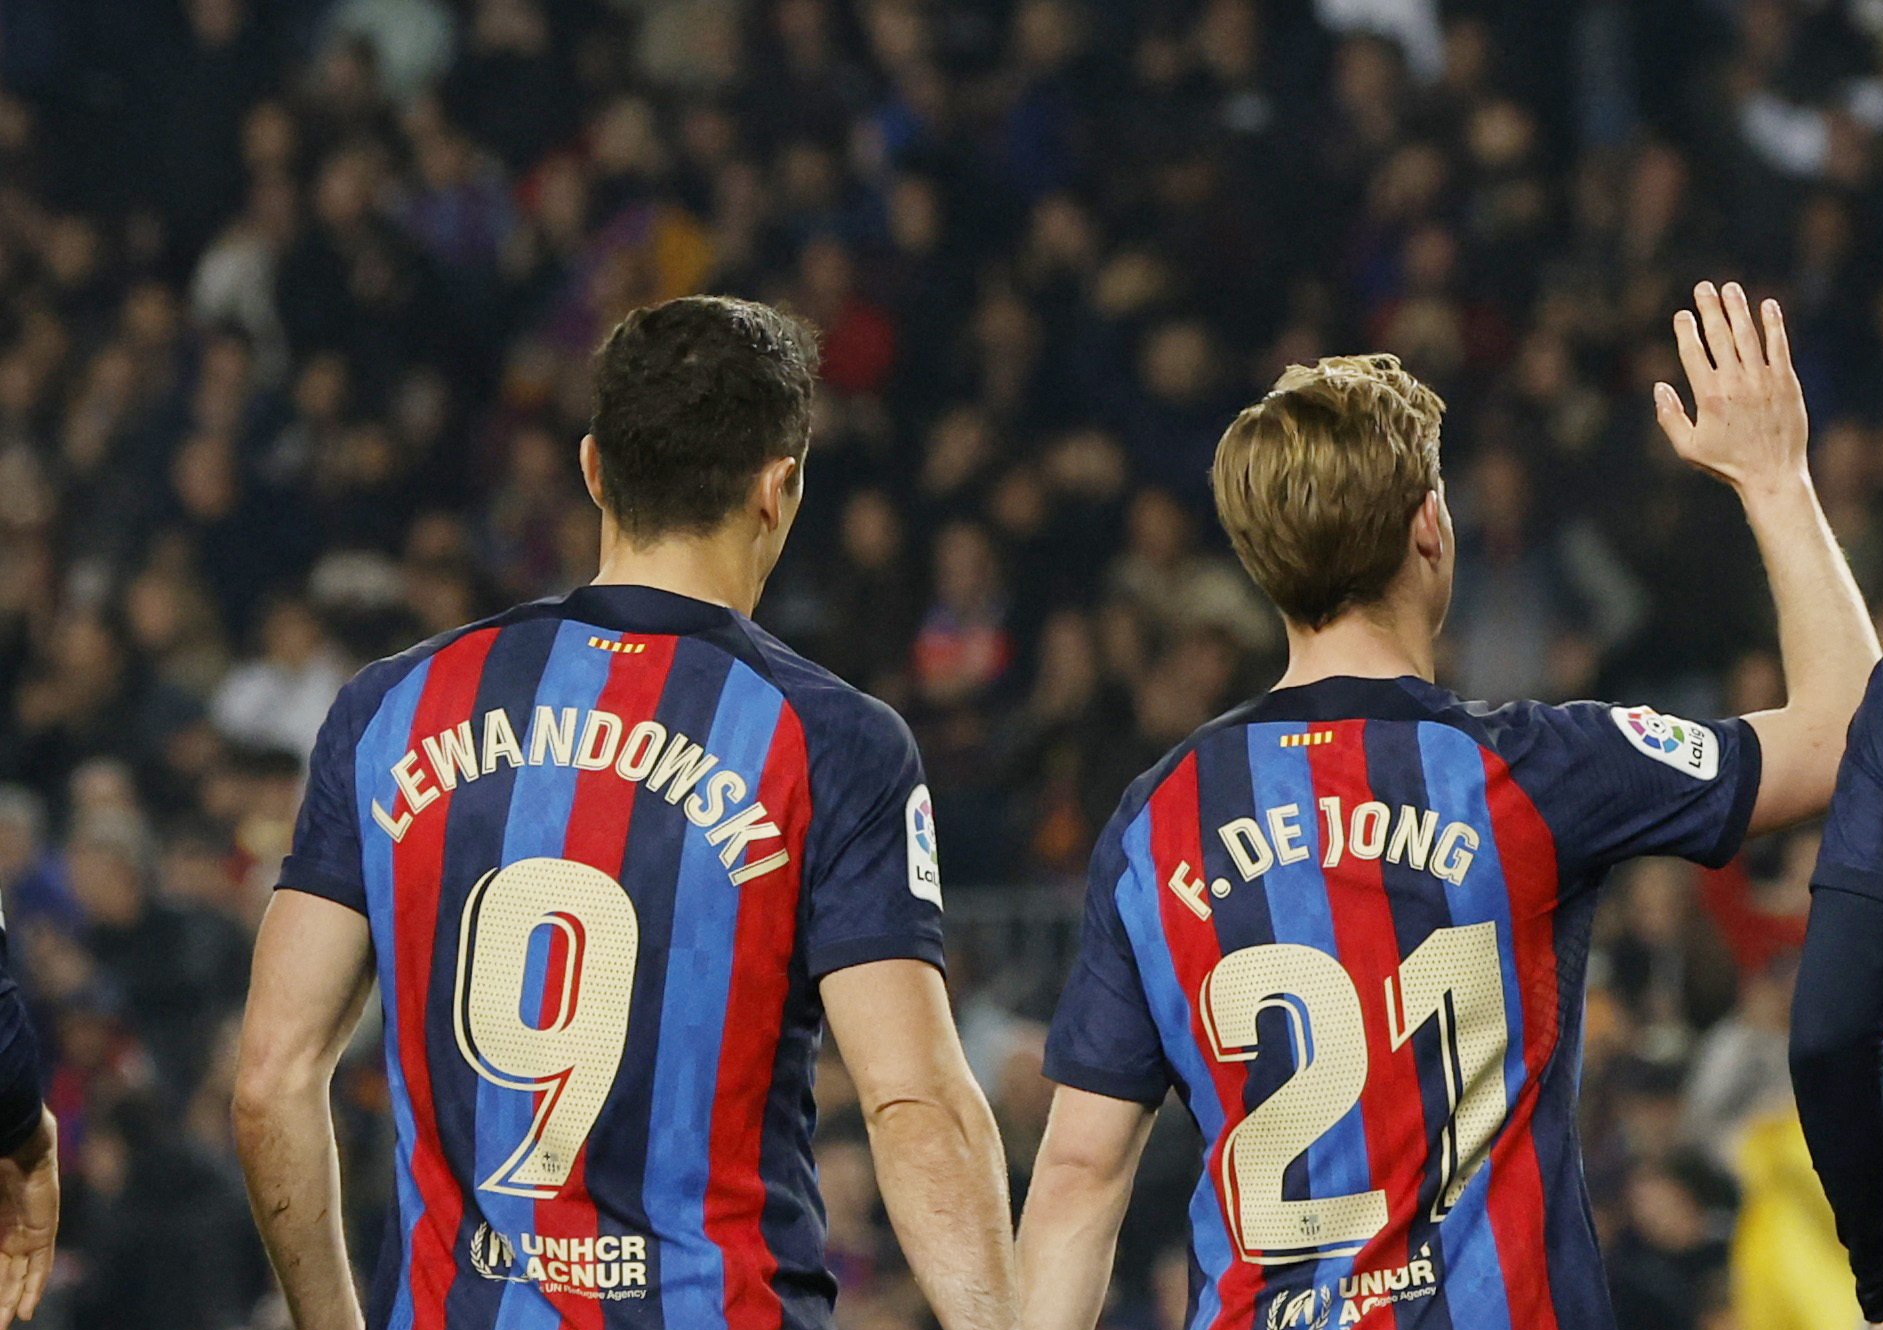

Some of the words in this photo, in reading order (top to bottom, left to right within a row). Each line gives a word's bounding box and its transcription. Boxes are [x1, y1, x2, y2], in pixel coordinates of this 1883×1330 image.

[1688, 727, 1705, 769] LaLig
[371, 705, 790, 887] LEWANDOWSKI
[1168, 860, 1232, 921] F.
[1217, 803, 1310, 882] DE
[1318, 796, 1480, 886] JONG
[453, 857, 640, 1199] 9
[1200, 920, 1507, 1266] 21
[521, 1233, 647, 1262] UNHCR
[527, 1256, 647, 1288] ACNUR
[607, 1289, 647, 1301] Agency
[1400, 1286, 1437, 1302] Agency
